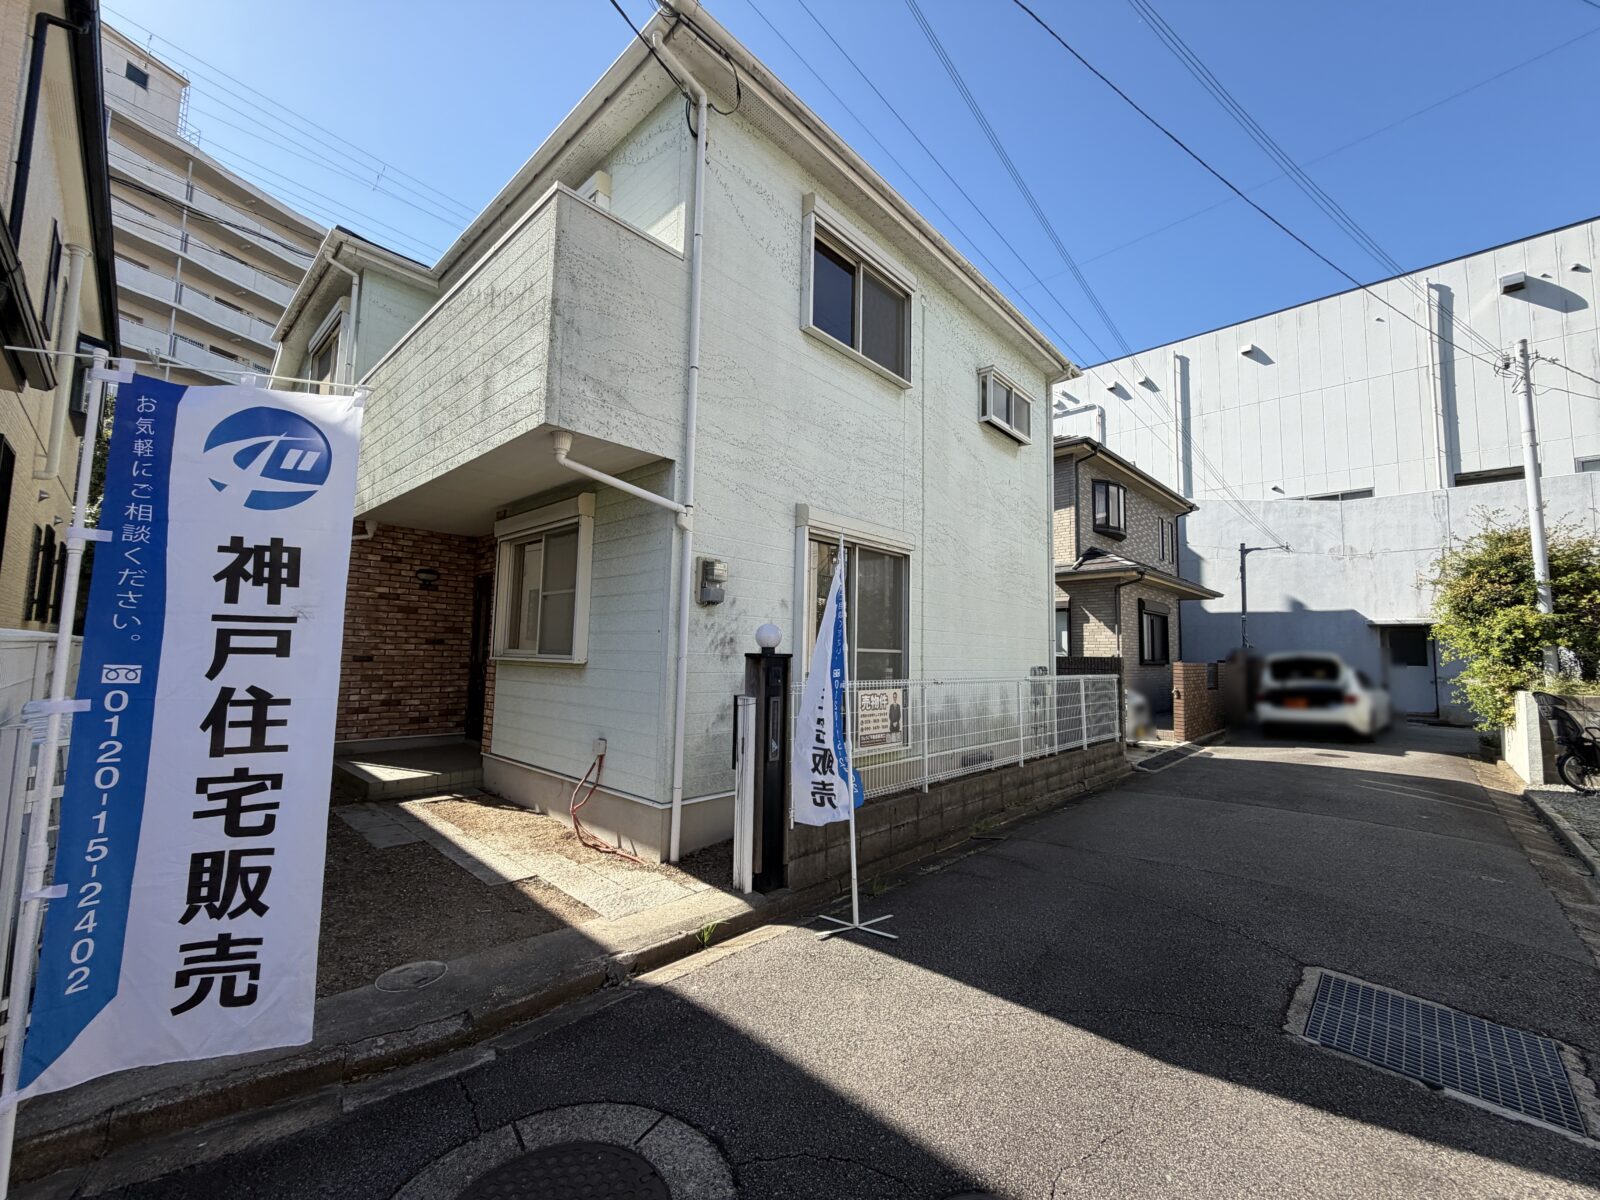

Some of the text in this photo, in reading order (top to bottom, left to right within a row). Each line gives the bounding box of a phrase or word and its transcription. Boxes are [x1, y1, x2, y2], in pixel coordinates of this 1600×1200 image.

[113, 394, 157, 642] お気軽にご相談ください。
[170, 536, 302, 1017] 神戸住宅販売
[860, 692, 889, 712] 売物件
[64, 690, 129, 996] 0120-15-2402
